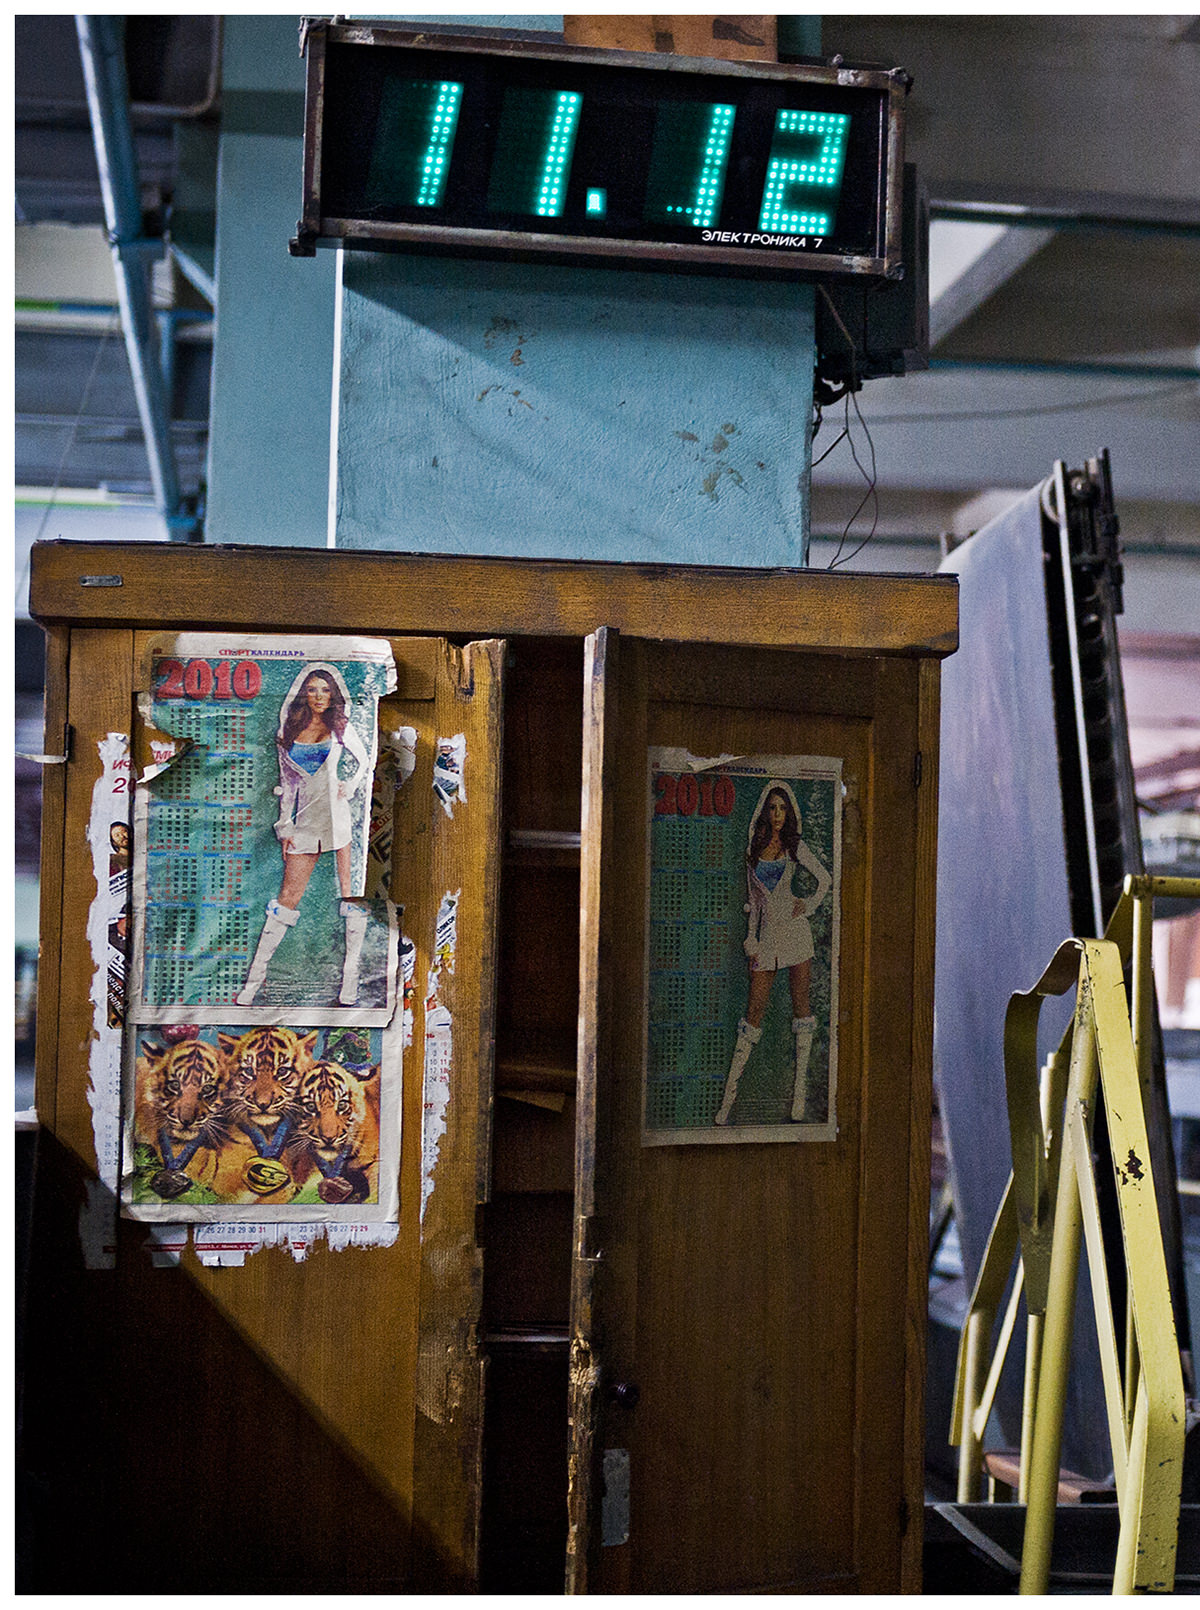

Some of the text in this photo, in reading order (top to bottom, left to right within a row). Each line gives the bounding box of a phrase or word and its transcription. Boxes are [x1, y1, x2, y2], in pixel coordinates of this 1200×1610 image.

[701, 229, 823, 249] ЭЛЕКТРОНИКА 7
[155, 660, 262, 700] 2010
[654, 774, 736, 817] 2010
[217, 1226, 225, 1234] 27
